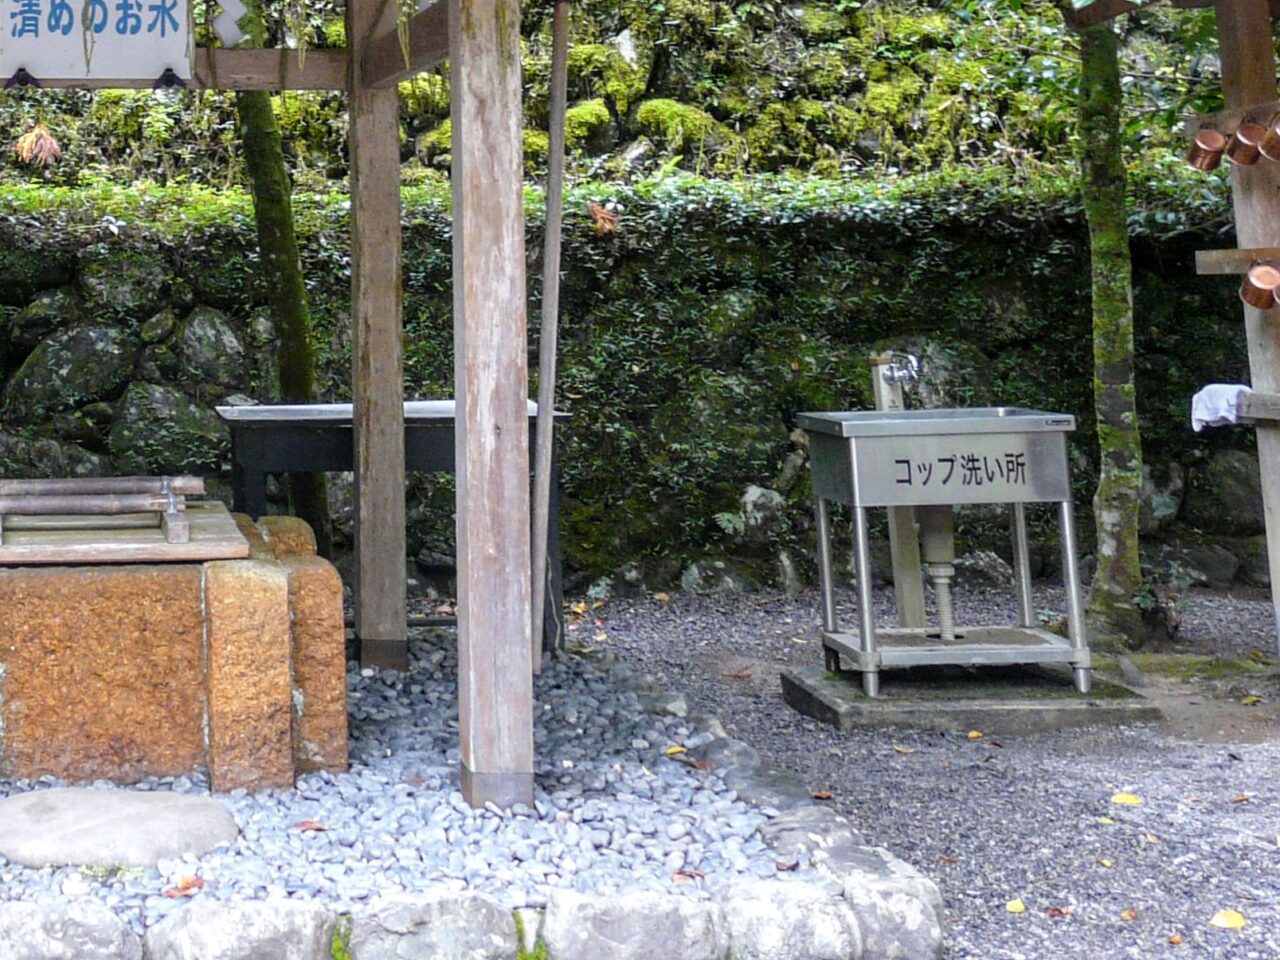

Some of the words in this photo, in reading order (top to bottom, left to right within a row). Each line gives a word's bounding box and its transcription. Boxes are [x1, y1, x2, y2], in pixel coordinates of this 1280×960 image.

[894, 453, 1027, 486] コップ洗い所
